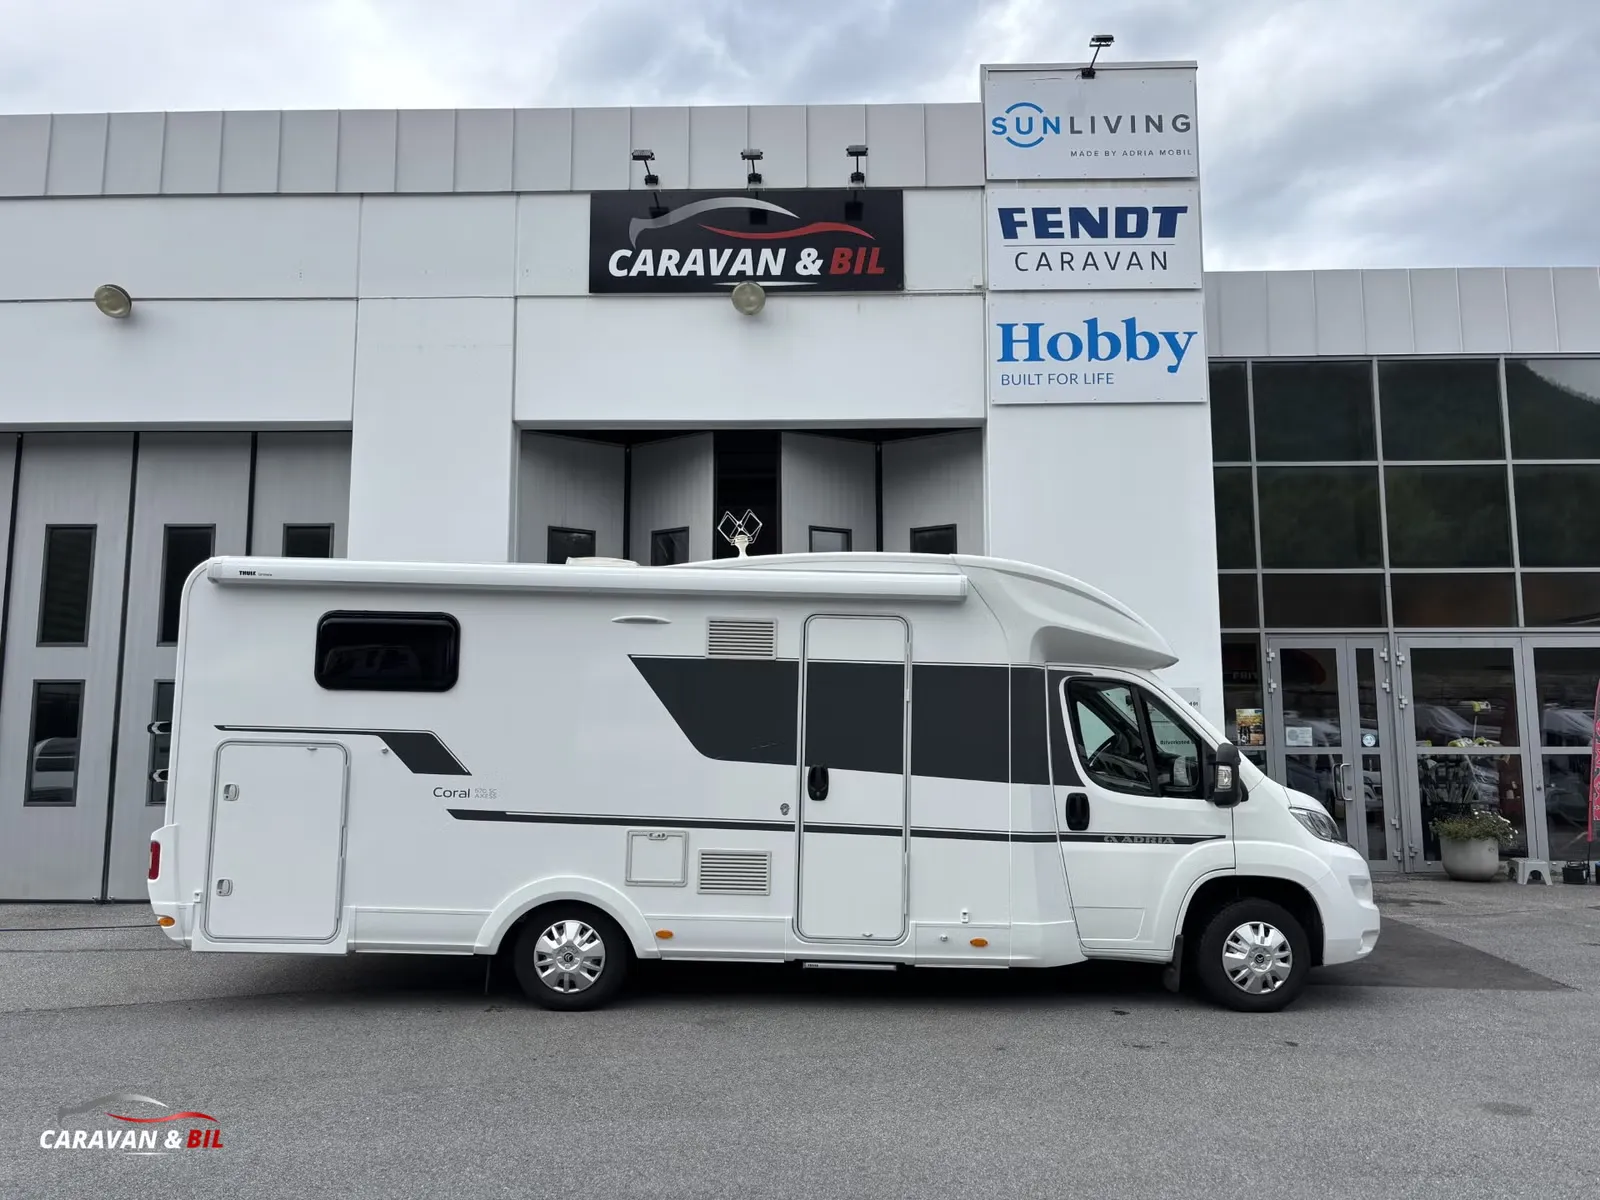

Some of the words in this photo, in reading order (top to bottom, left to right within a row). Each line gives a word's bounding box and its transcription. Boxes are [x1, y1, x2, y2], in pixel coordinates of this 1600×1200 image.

[998, 206, 1188, 239] FENDT
[608, 248, 785, 277] CARAVAN
[795, 248, 823, 276] &
[830, 247, 884, 274] BIL
[1015, 251, 1168, 271] CARAVAN
[996, 316, 1198, 373] Hobby
[1001, 373, 1043, 386] BUILT
[1048, 373, 1079, 385] FOR
[1084, 372, 1114, 385] LIFE
[433, 787, 470, 798] Coral
[1122, 836, 1175, 844] ADRIA
